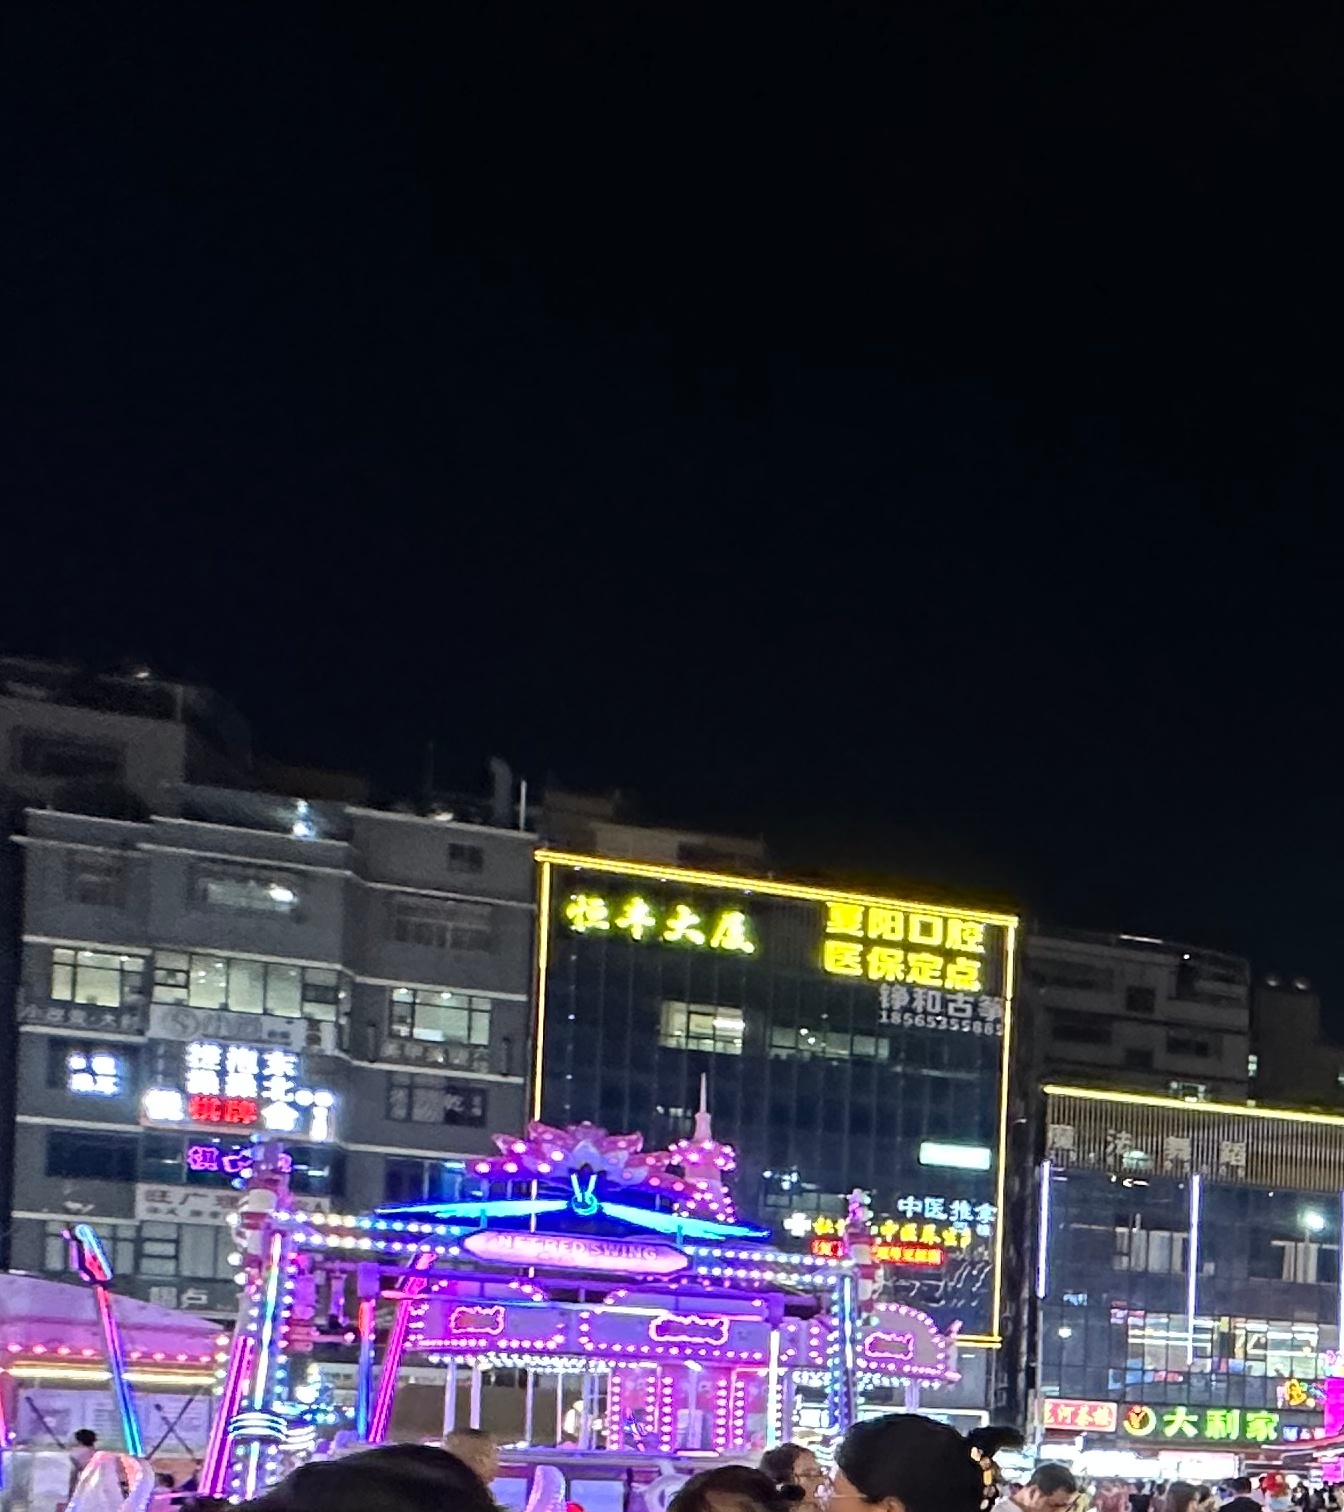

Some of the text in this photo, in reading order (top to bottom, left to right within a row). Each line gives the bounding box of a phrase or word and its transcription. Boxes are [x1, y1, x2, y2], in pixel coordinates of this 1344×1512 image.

[824, 939, 982, 993] 医保定点
[897, 1195, 998, 1223] 中医推拿
[1163, 1405, 1280, 1442] 大利家
